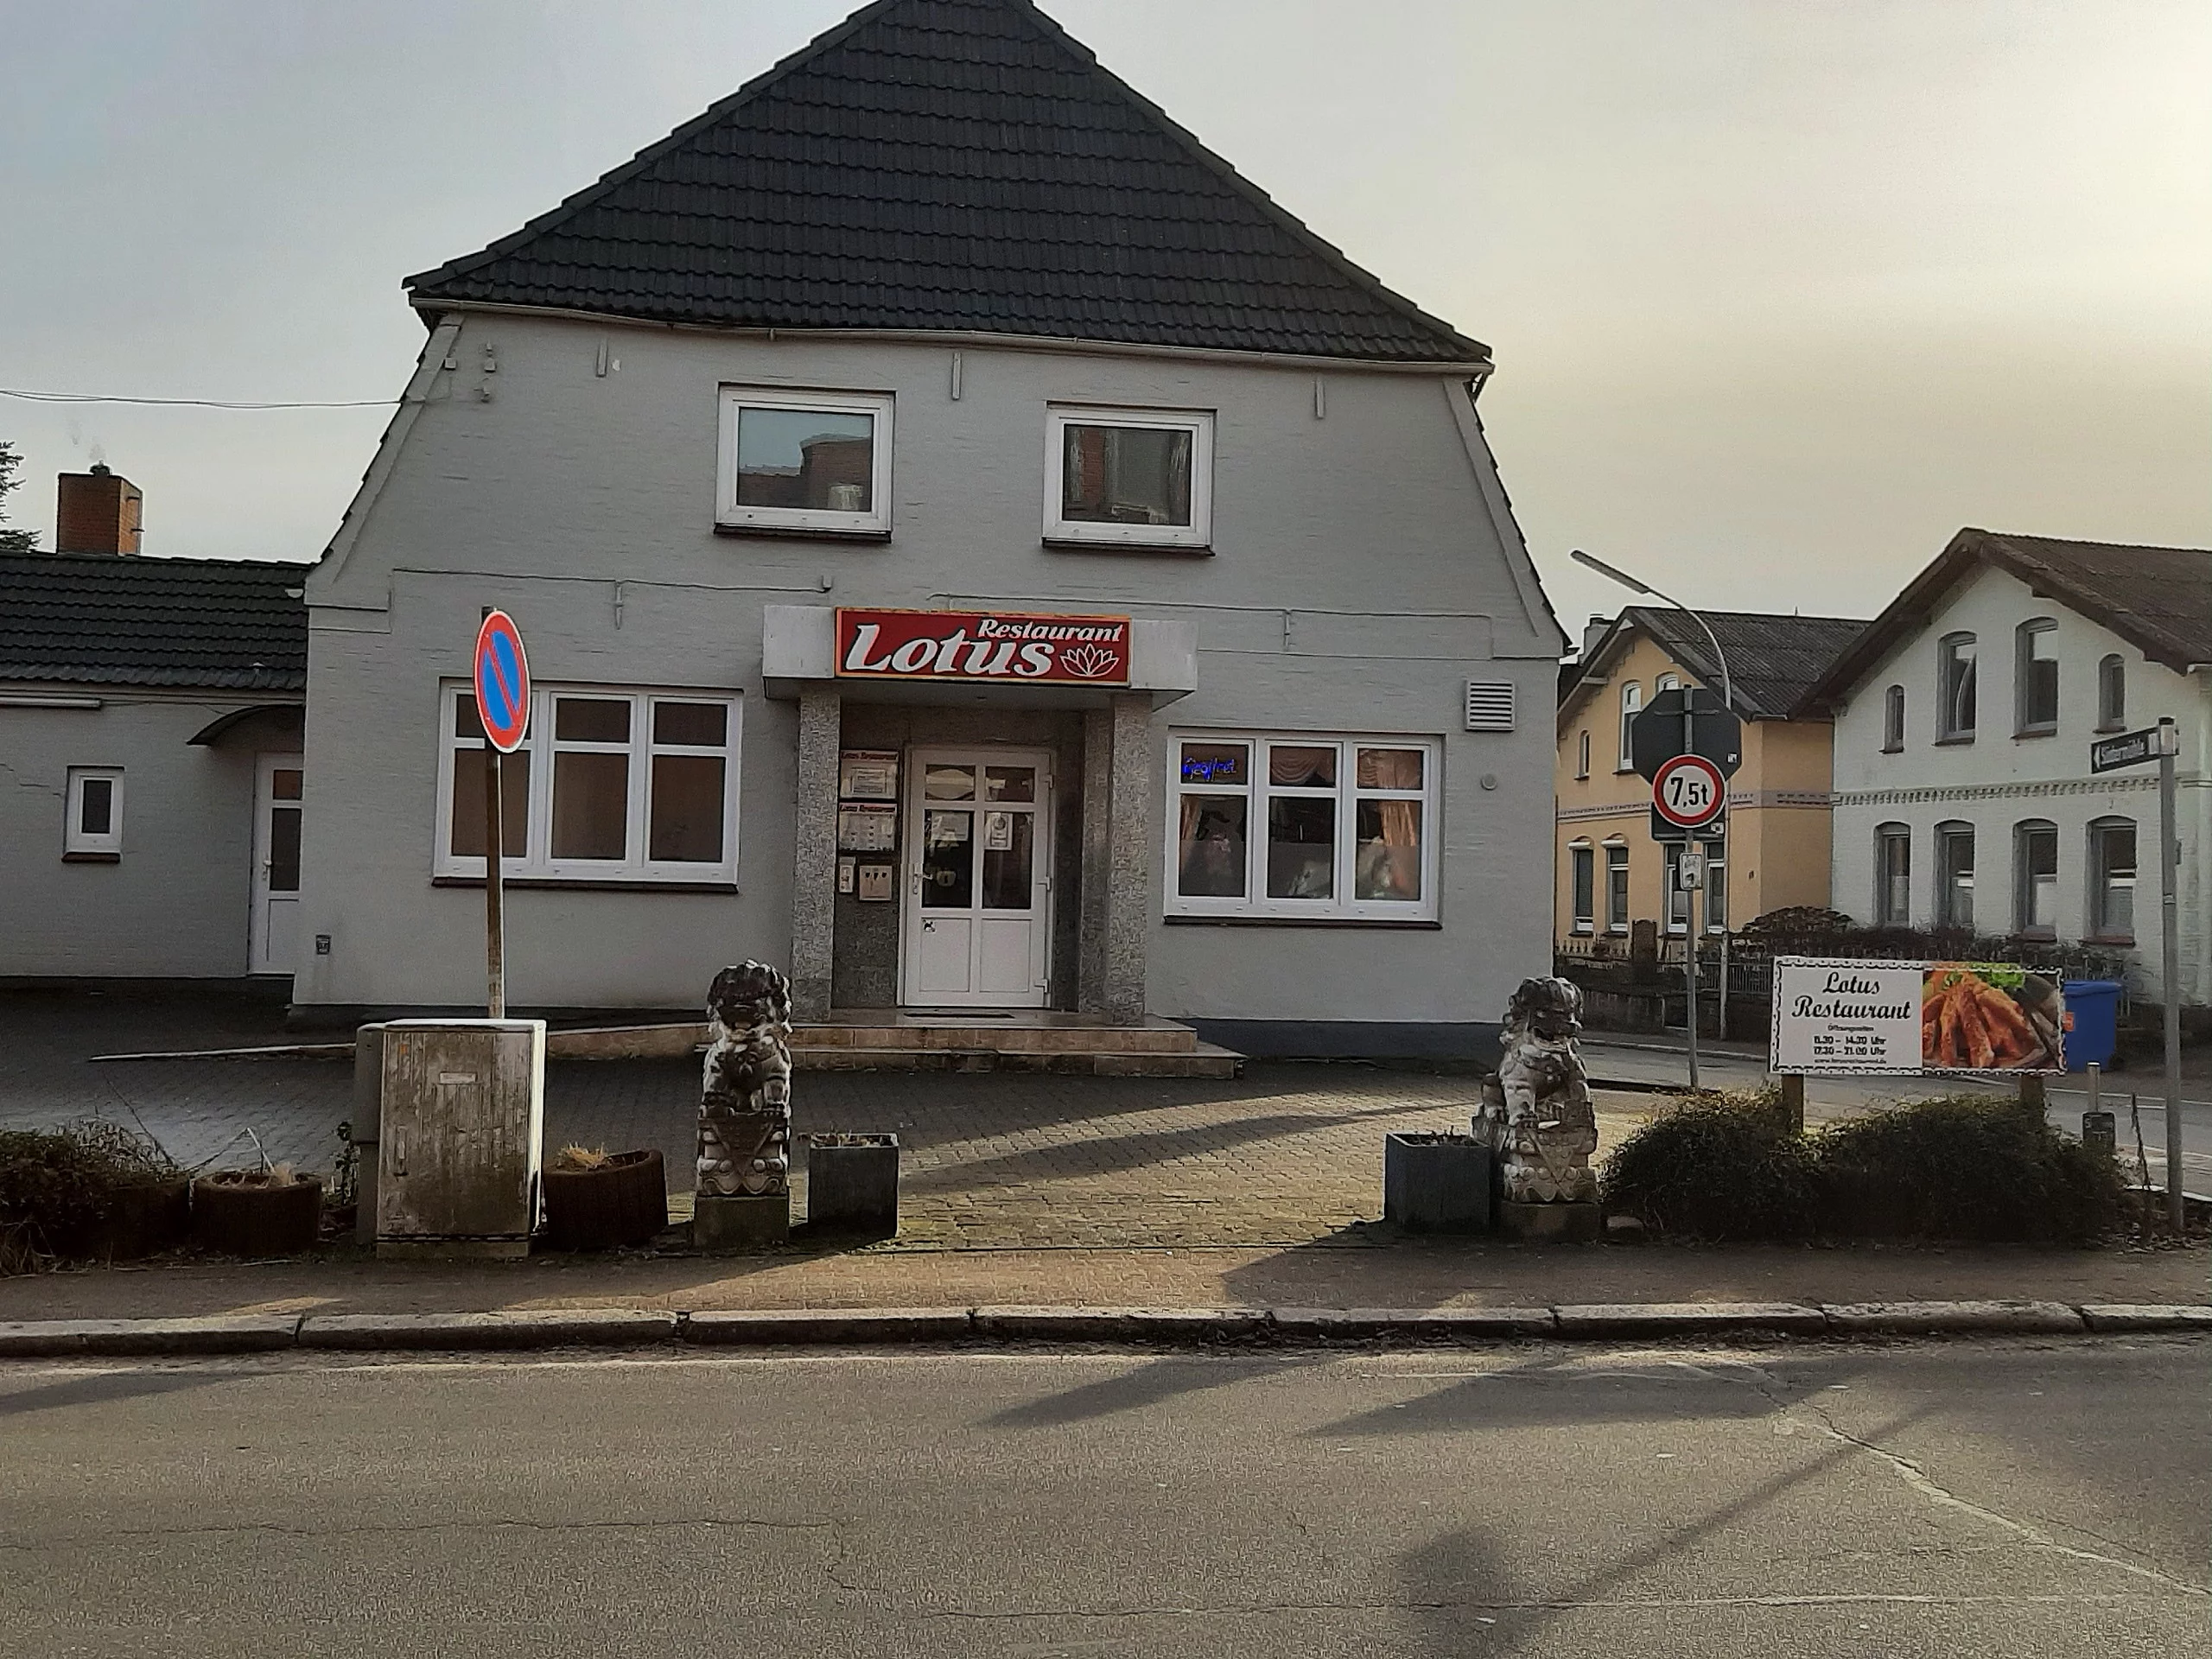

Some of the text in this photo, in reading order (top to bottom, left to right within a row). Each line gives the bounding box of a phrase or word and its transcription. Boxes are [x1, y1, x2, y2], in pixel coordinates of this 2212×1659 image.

[977, 619, 1123, 642] Restaurant
[845, 624, 1056, 677] Lotus
[1670, 777, 1709, 808] 7,5t
[1822, 971, 1880, 995] Lotus
[1791, 995, 1911, 1020] Restaurant
[1844, 1046, 1867, 1055] 21.00
[1871, 1046, 1886, 1055] Uhr
[1871, 1036, 1886, 1045] Uhr
